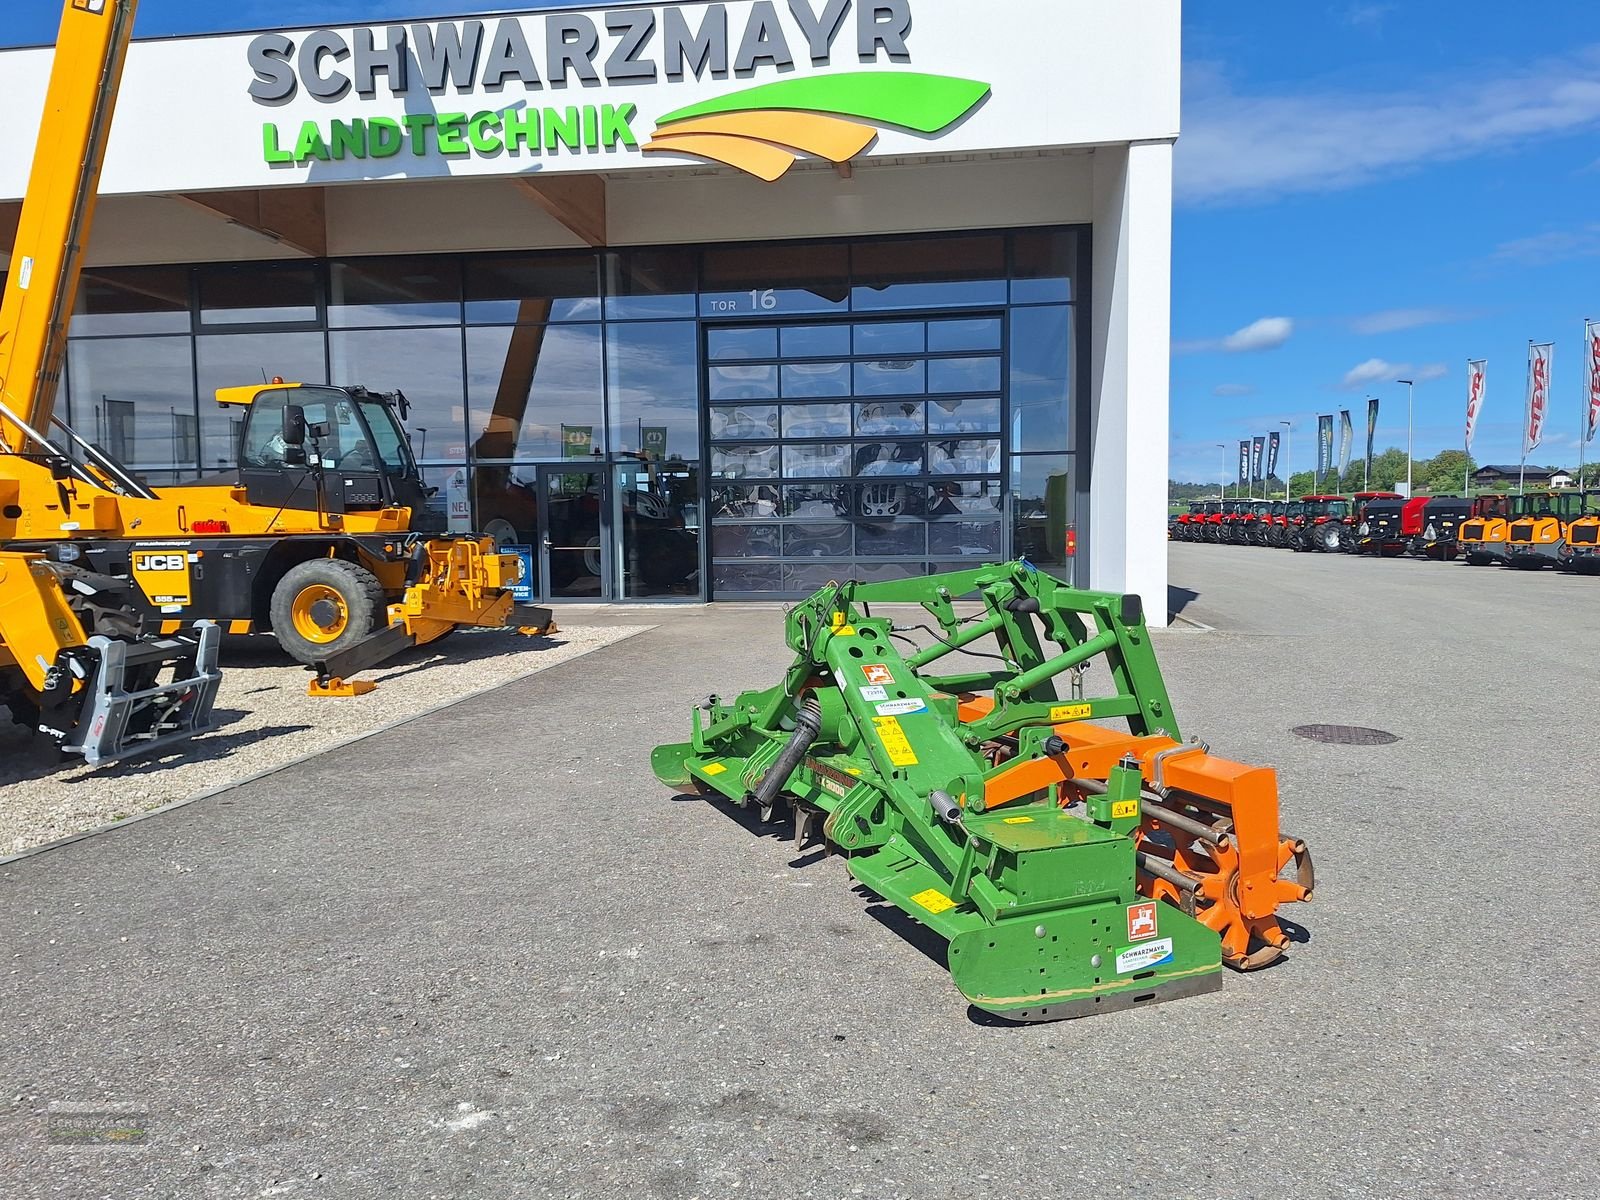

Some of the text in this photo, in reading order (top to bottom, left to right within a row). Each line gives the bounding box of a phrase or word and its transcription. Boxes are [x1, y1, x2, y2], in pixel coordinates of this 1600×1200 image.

[247, 0, 911, 101] SCHWARZMAYR
[262, 103, 638, 163] LANDTECHNIK
[711, 289, 777, 311] TOR 16
[1529, 358, 1546, 442] STEYR
[136, 555, 184, 570] JCB
[1121, 945, 1165, 960] SCHWARZMAYR
